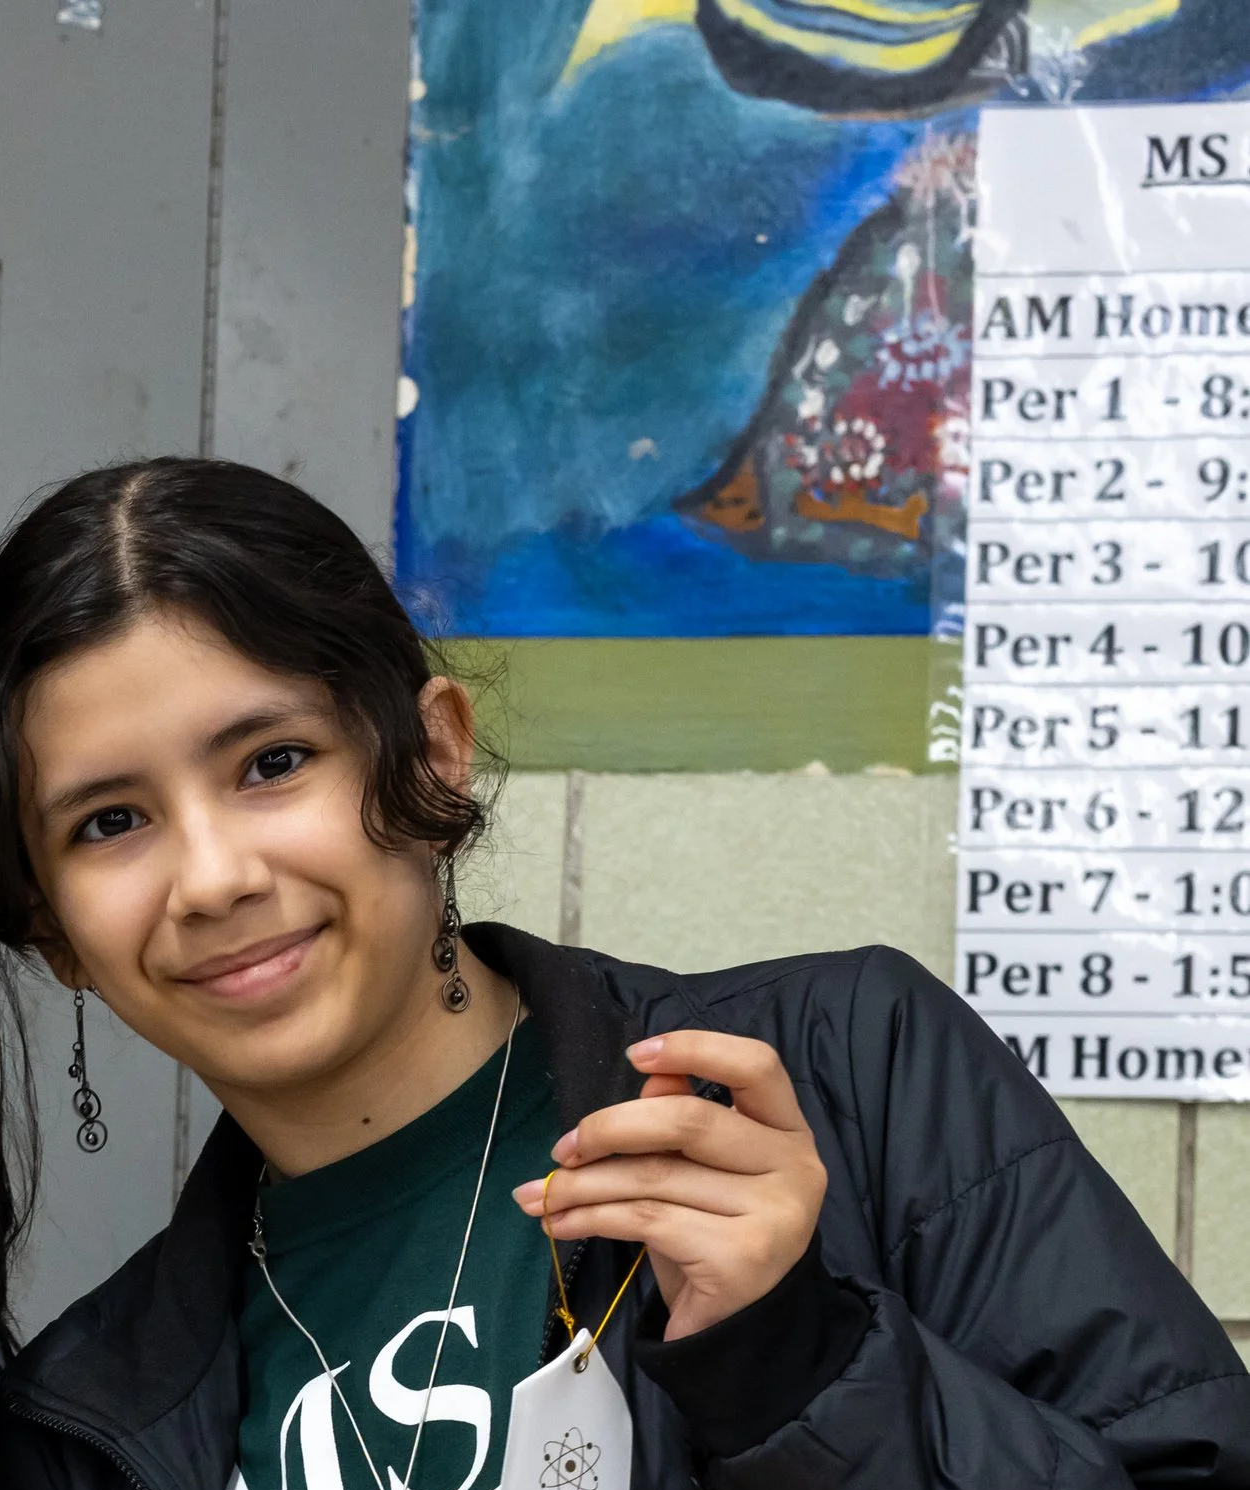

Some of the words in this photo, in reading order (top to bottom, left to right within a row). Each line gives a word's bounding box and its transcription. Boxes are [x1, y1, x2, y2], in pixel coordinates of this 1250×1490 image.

[1146, 134, 1229, 179] MS
[981, 296, 1072, 340] AM
[981, 379, 1077, 421] Per
[1098, 378, 1124, 421] 1
[979, 459, 1076, 502] Per
[1094, 458, 1125, 502] 2
[976, 542, 1075, 584] Per
[1092, 541, 1123, 585] 3
[974, 623, 1071, 667] Per
[1088, 623, 1123, 666] 4
[972, 705, 1069, 749] Per
[1087, 705, 1119, 750] 5
[969, 788, 1067, 831] Per
[1084, 788, 1118, 832] 6
[966, 870, 1063, 913] Per
[1083, 870, 1116, 913] 7
[965, 952, 1062, 996] Per
[1079, 952, 1113, 996] 8
[1071, 1034, 1250, 1080] Home
